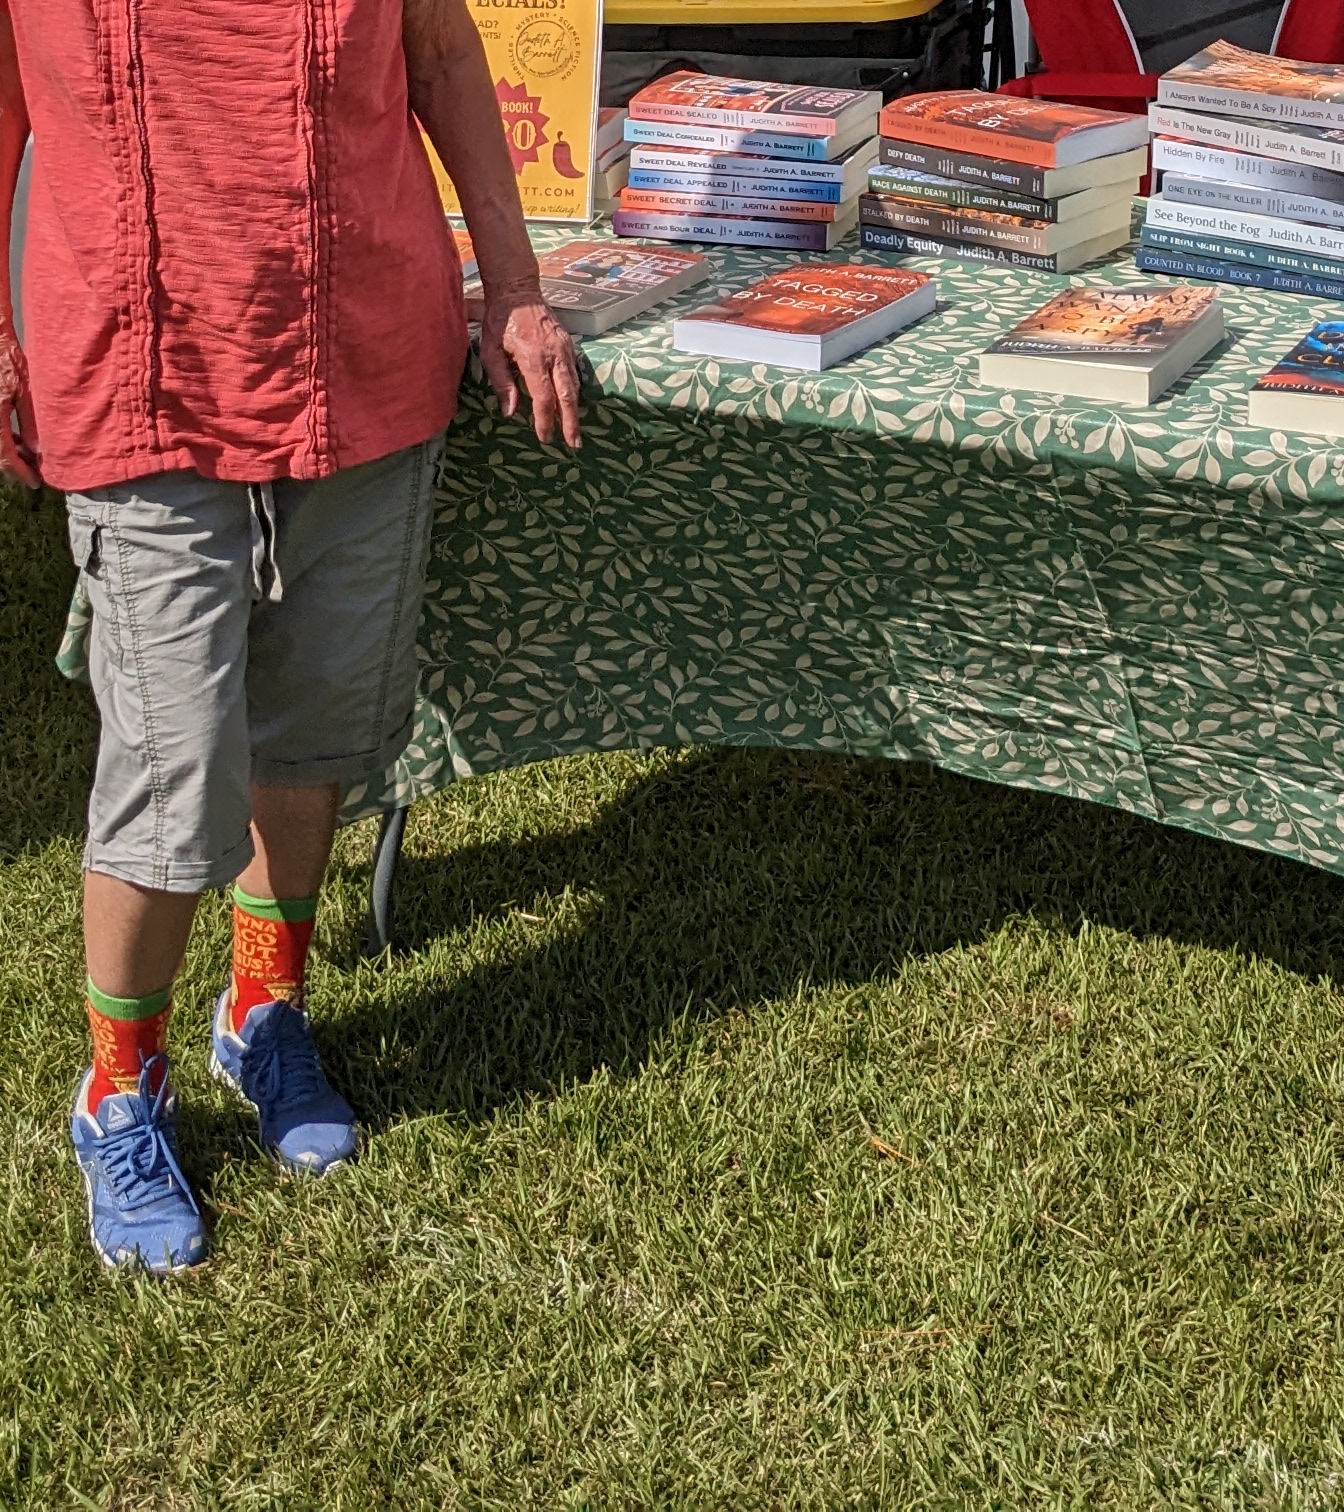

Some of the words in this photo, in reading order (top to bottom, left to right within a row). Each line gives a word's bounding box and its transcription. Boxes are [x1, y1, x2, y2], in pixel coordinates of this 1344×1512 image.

[516, 12, 550, 30] MYSTERY
[559, 16, 580, 46] SCIENCE
[508, 43, 525, 80] THRILLER
[502, 102, 534, 114] BOOK!
[1170, 92, 1196, 102] Always
[1198, 95, 1226, 106] Wanted
[1241, 101, 1251, 109] Be
[1262, 103, 1276, 113] Spy
[1301, 110, 1323, 119] Judith
[1326, 113, 1334, 121] A.
[1157, 117, 1171, 127] Red
[1182, 122, 1194, 131] The
[1197, 125, 1212, 135] New
[1214, 129, 1231, 139] Gray
[1265, 141, 1287, 150] Judith
[1301, 147, 1326, 159] Barrett
[887, 149, 903, 159] DEFY
[905, 152, 925, 164] DEATH
[959, 166, 981, 176] JUDITH
[992, 172, 1020, 185] BARRETT
[1164, 146, 1193, 159] Hidden
[1196, 151, 1206, 162] By
[1209, 154, 1225, 164] Fire
[626, 194, 656, 203] SWEET
[659, 197, 691, 205] SECRET
[694, 199, 717, 207] DEAL
[741, 202, 769, 210] JUDITH
[780, 205, 815, 214] BARRETT
[872, 179, 890, 189] RACE
[892, 184, 922, 195] AGAINST
[924, 188, 948, 198] DEATH
[973, 195, 998, 206] JUDITH
[1008, 201, 1040, 213] BARRETT
[1168, 184, 1185, 194] ONE
[1188, 187, 1203, 197] EYE
[1234, 194, 1262, 205] KILLER
[1288, 203, 1318, 215] JUDITH
[1321, 208, 1330, 216] A.
[862, 208, 893, 219] STALKED
[895, 213, 904, 221] BY
[906, 215, 929, 226] DEATH
[962, 225, 987, 236] JUDITH
[997, 231, 1029, 243] BARRETT
[1154, 209, 1174, 221] See
[1177, 213, 1217, 229] Beyond
[1219, 219, 1237, 231] the
[1240, 224, 1261, 238] Fog
[1268, 228, 1303, 243] Judith
[1305, 235, 1316, 245] A.
[865, 231, 904, 249] Deadly
[907, 237, 944, 254] Equity
[956, 245, 995, 260] Judith
[997, 251, 1008, 262] A.
[1012, 252, 1054, 269] Barrett
[855, 272, 918, 286] BARRETT
[1145, 257, 1183, 270] COUNTED
[1186, 262, 1195, 272] IN
[1197, 264, 1224, 276] BLOOD
[1229, 270, 1252, 281] BOOK
[1255, 273, 1261, 282] 7
[1273, 276, 1302, 289] JUDITH
[732, 290, 773, 301] BY
[773, 296, 868, 317] DEATH
[771, 279, 879, 303] TAGGED
